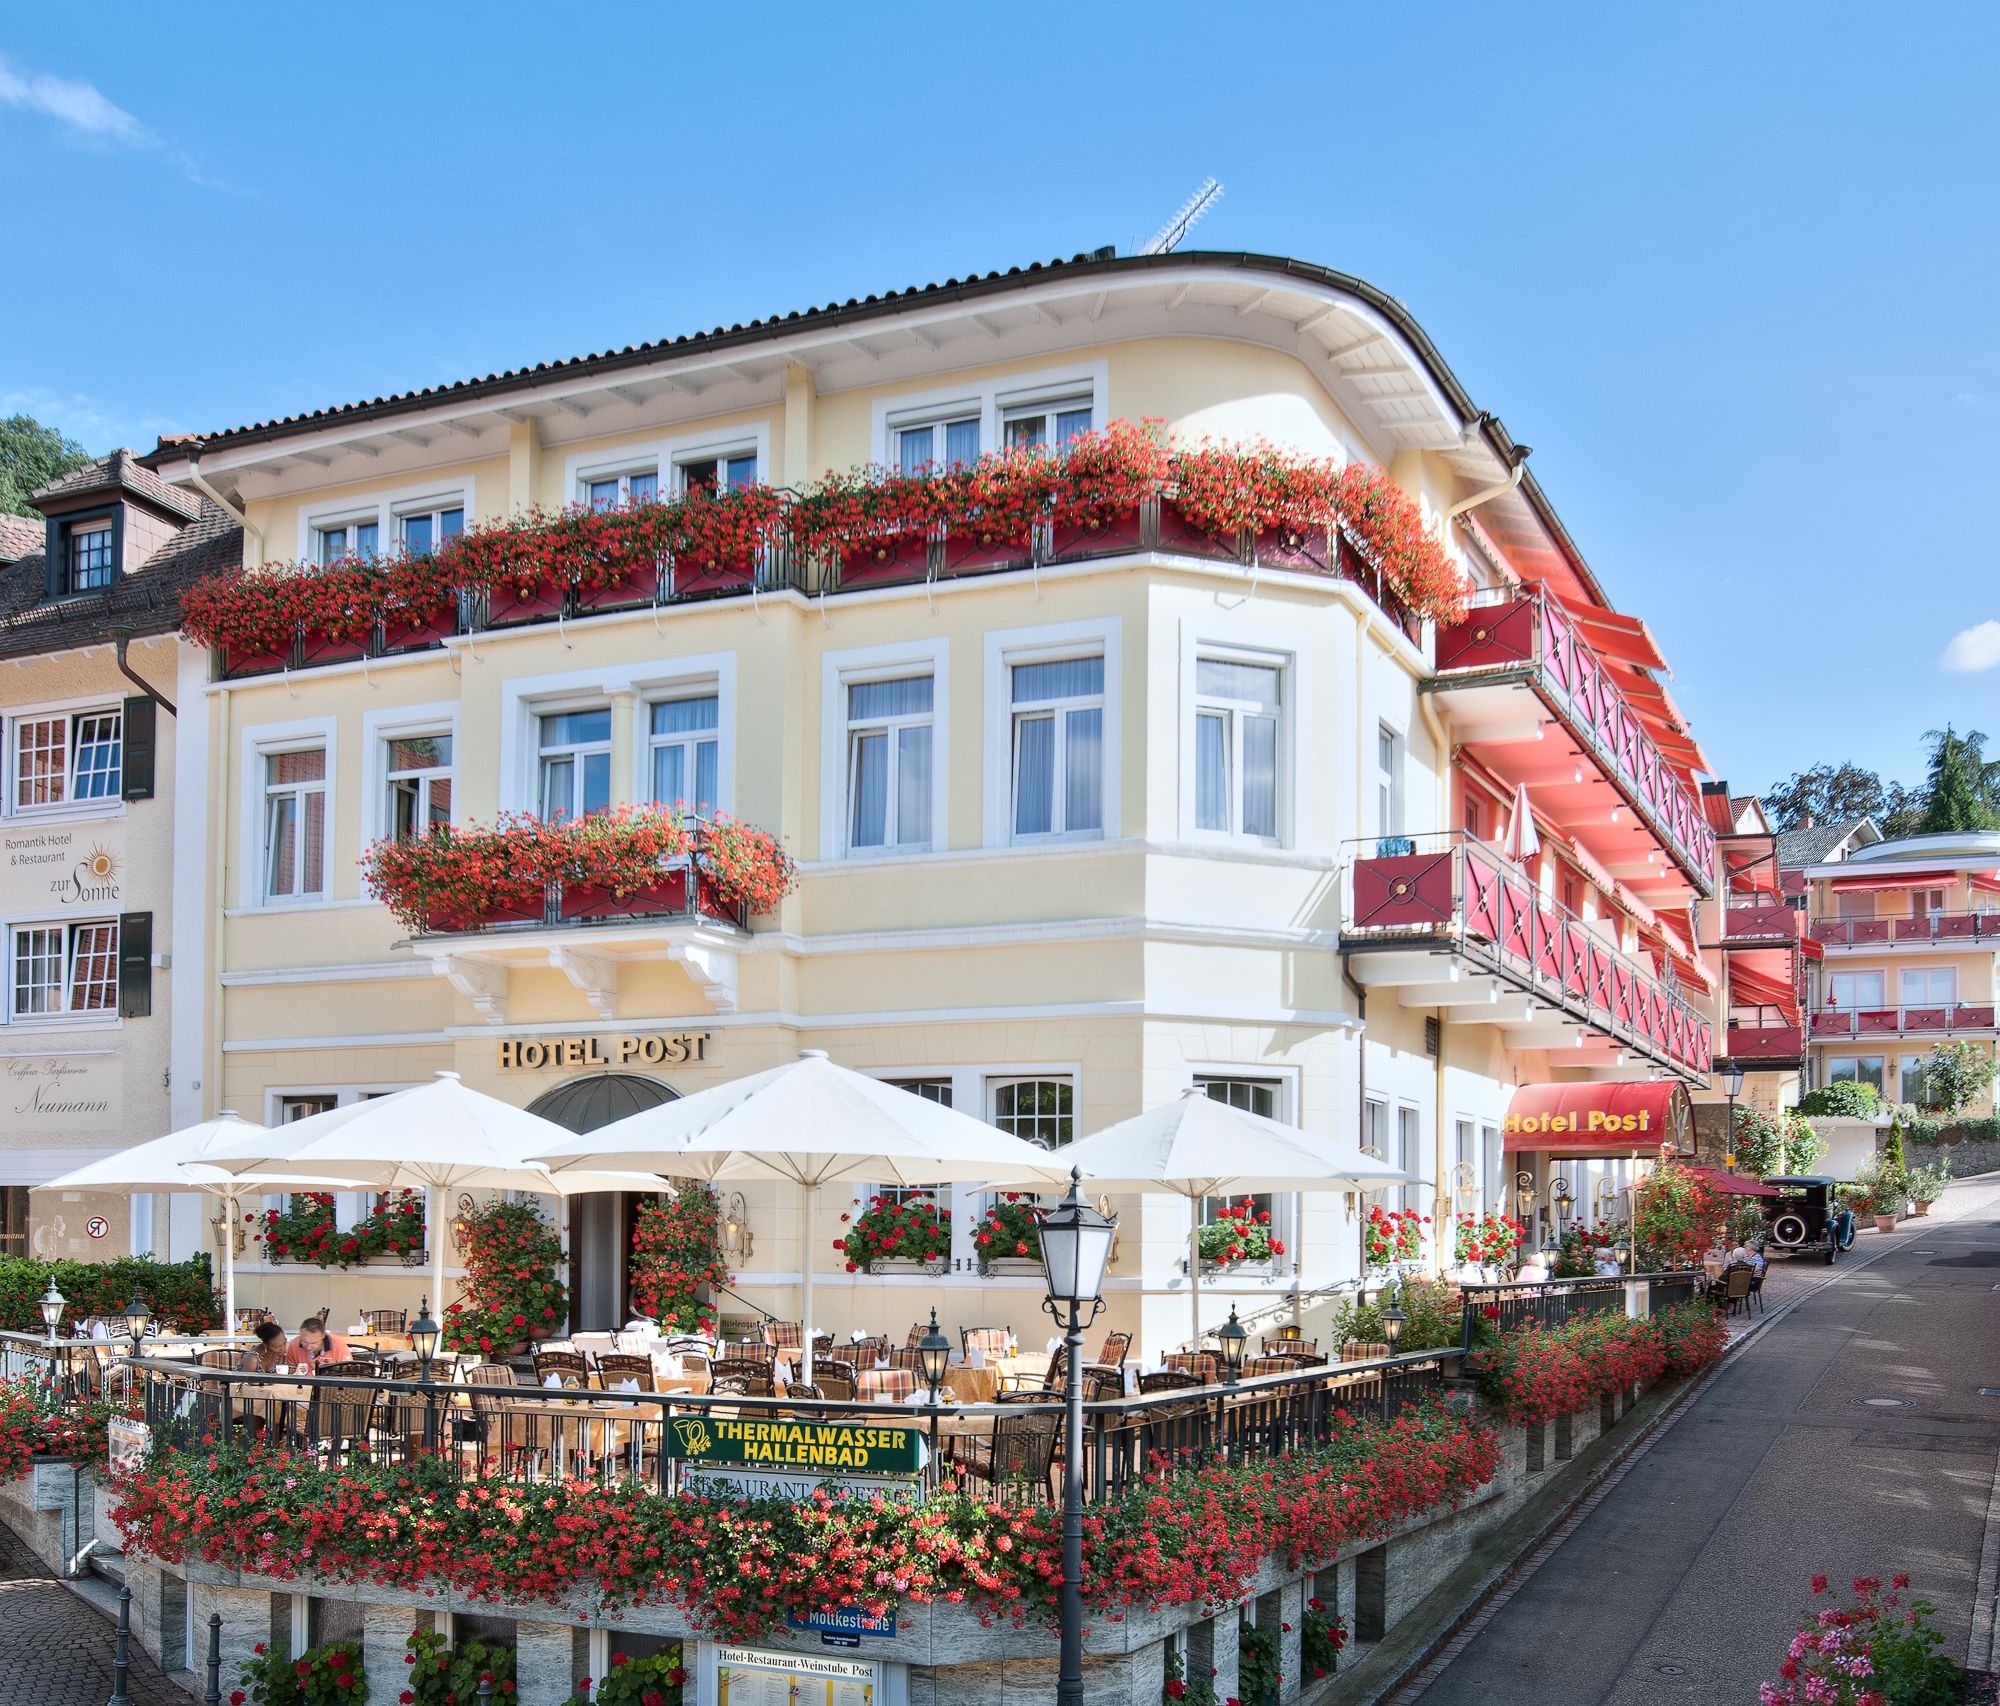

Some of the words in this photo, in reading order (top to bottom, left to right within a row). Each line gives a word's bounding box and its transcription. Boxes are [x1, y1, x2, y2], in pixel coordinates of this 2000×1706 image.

[5, 836, 46, 850] Romantik
[48, 833, 72, 845] Hotel
[10, 855, 17, 866] &
[19, 852, 66, 865] Restaurant
[50, 880, 71, 892] zur
[61, 862, 120, 904] Sonne
[497, 1038, 609, 1068] HOTEL
[615, 1033, 710, 1064] POST
[14, 1081, 109, 1113] Neumann
[1504, 1111, 1577, 1133] Hotel
[1588, 1110, 1650, 1132] Post
[722, 1320, 758, 1330] Hoteleingan
[715, 1421, 907, 1449] THERMALWASSER
[743, 1442, 869, 1467] HALLENBAD
[689, 1475, 810, 1500] RESTAURANT
[814, 1482, 917, 1504] EÖFET
[719, 1649, 848, 1674] Hotel-Restaurant-Weinstube
[852, 1665, 873, 1677] Post
